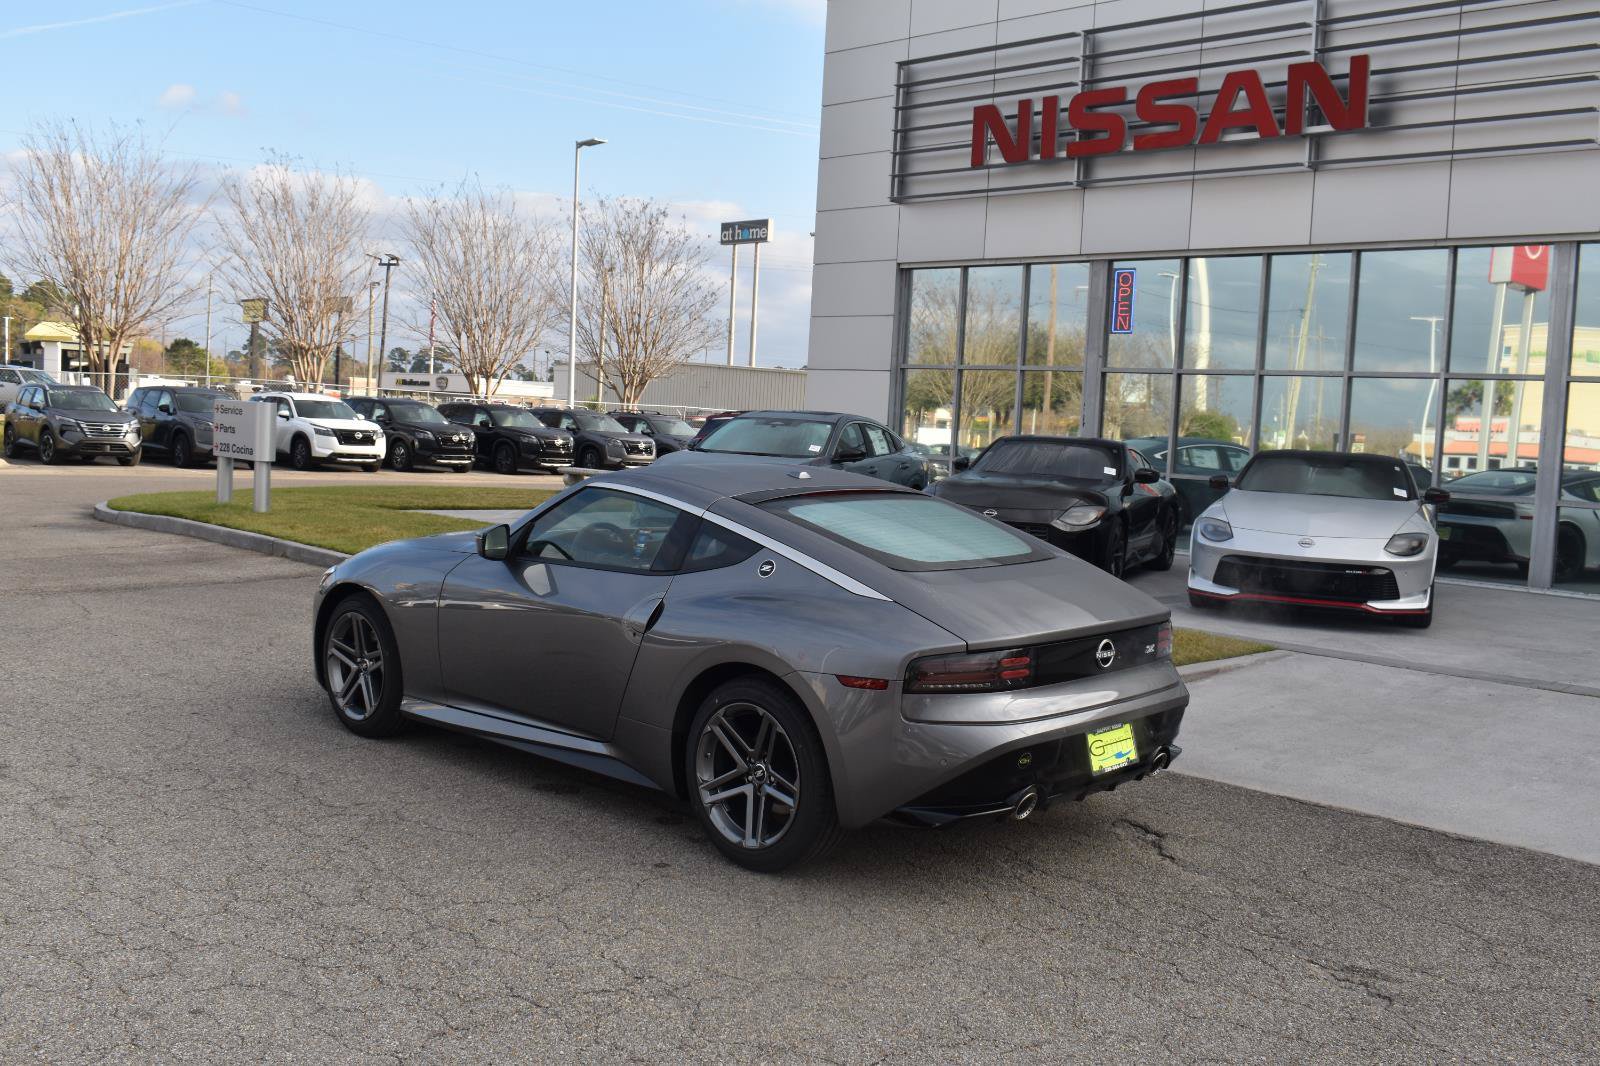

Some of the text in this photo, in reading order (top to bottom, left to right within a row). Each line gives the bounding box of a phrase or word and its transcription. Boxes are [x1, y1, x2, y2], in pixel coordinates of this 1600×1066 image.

[970, 54, 1370, 168] NISSAN
[721, 224, 768, 241] at home
[1117, 273, 1132, 330] OPEN
[219, 404, 244, 416] Service
[219, 423, 236, 434] Parts
[231, 443, 254, 456] Cocina
